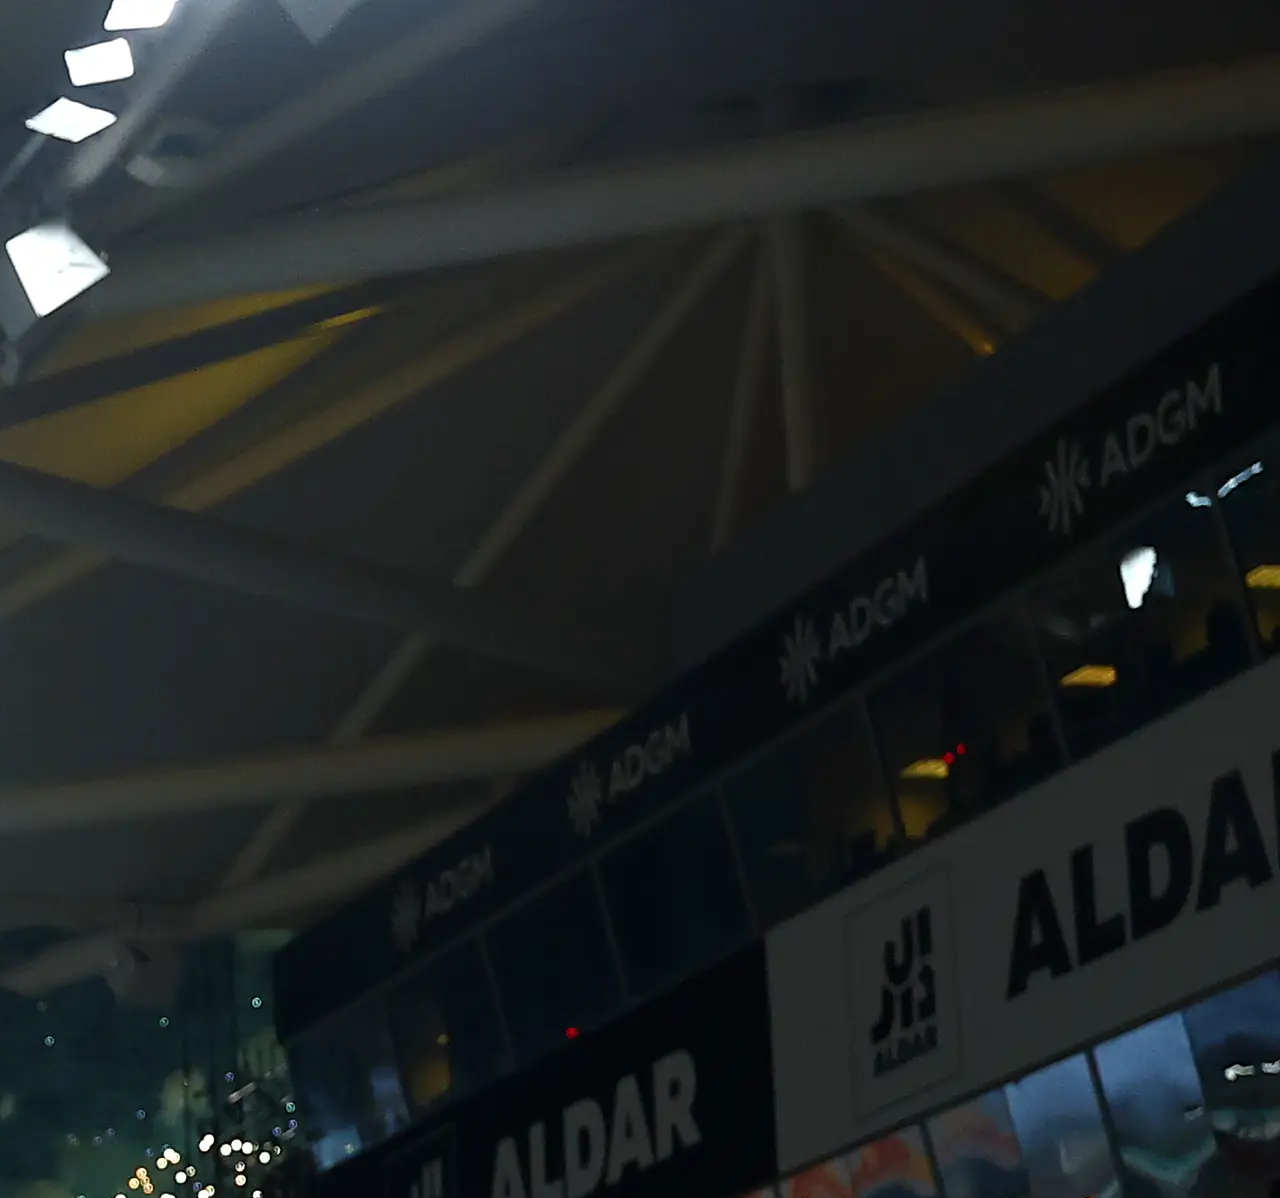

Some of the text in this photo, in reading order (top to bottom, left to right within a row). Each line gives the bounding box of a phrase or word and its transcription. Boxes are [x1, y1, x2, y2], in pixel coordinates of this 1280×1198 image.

[1100, 362, 1224, 489] ADGM
[830, 554, 929, 660] ADGM
[608, 710, 691, 805] ADGM
[1007, 747, 1280, 1000] ALDA
[874, 1025, 938, 1077] ALDAR
